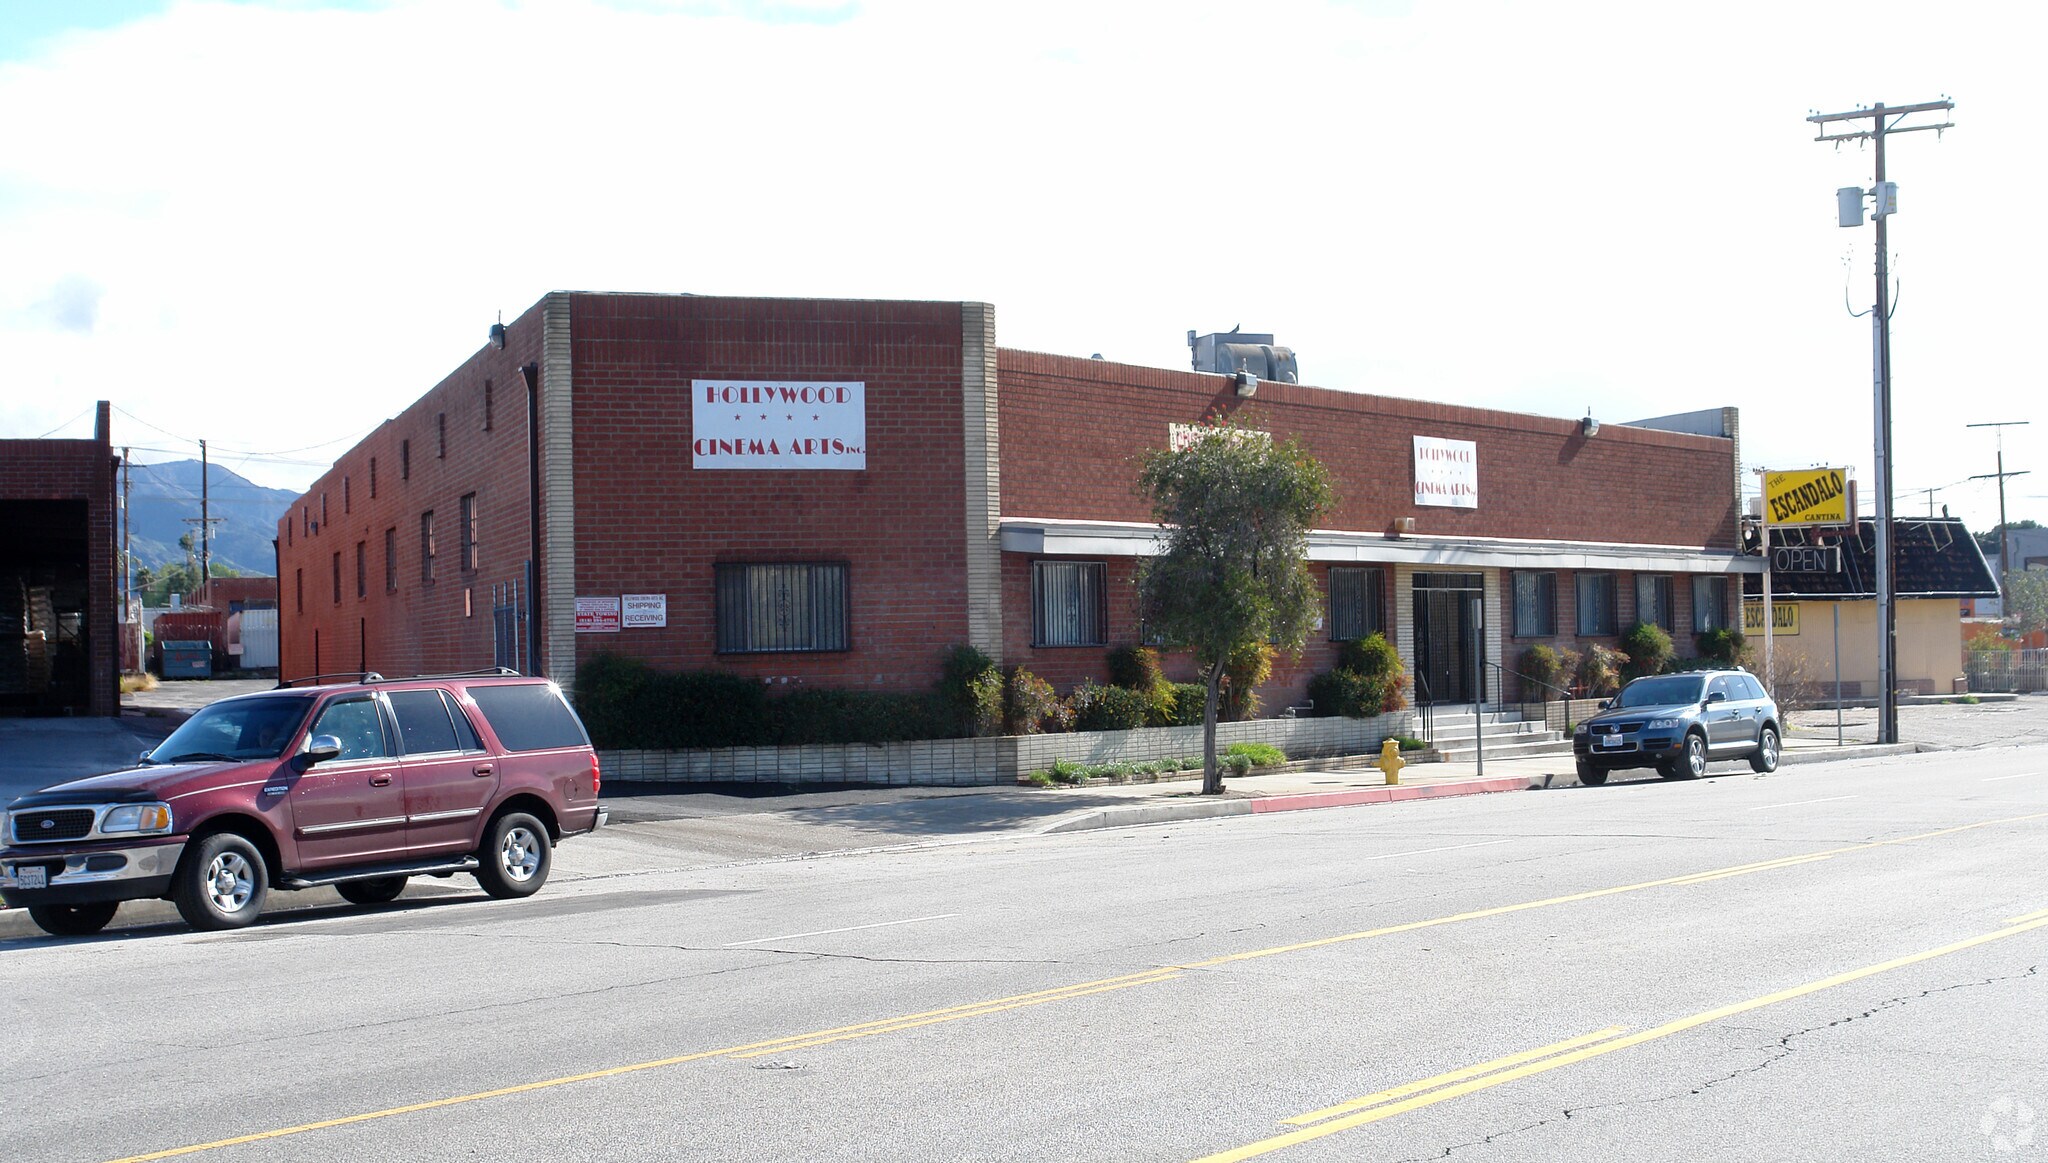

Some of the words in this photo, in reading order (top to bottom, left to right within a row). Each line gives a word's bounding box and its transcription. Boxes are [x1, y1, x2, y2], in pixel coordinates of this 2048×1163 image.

[706, 386, 852, 404] HOLLYWOOD
[694, 438, 780, 456] CINEMA
[789, 438, 845, 456] ARTS
[846, 446, 866, 454] INC.
[1768, 474, 1786, 489] THE
[1769, 471, 1843, 522] ESCANDALO
[1804, 513, 1841, 521] CANTINA
[1776, 548, 1827, 571] OPEN
[627, 602, 662, 610] SHIPPING
[625, 614, 664, 622] RECEIVING
